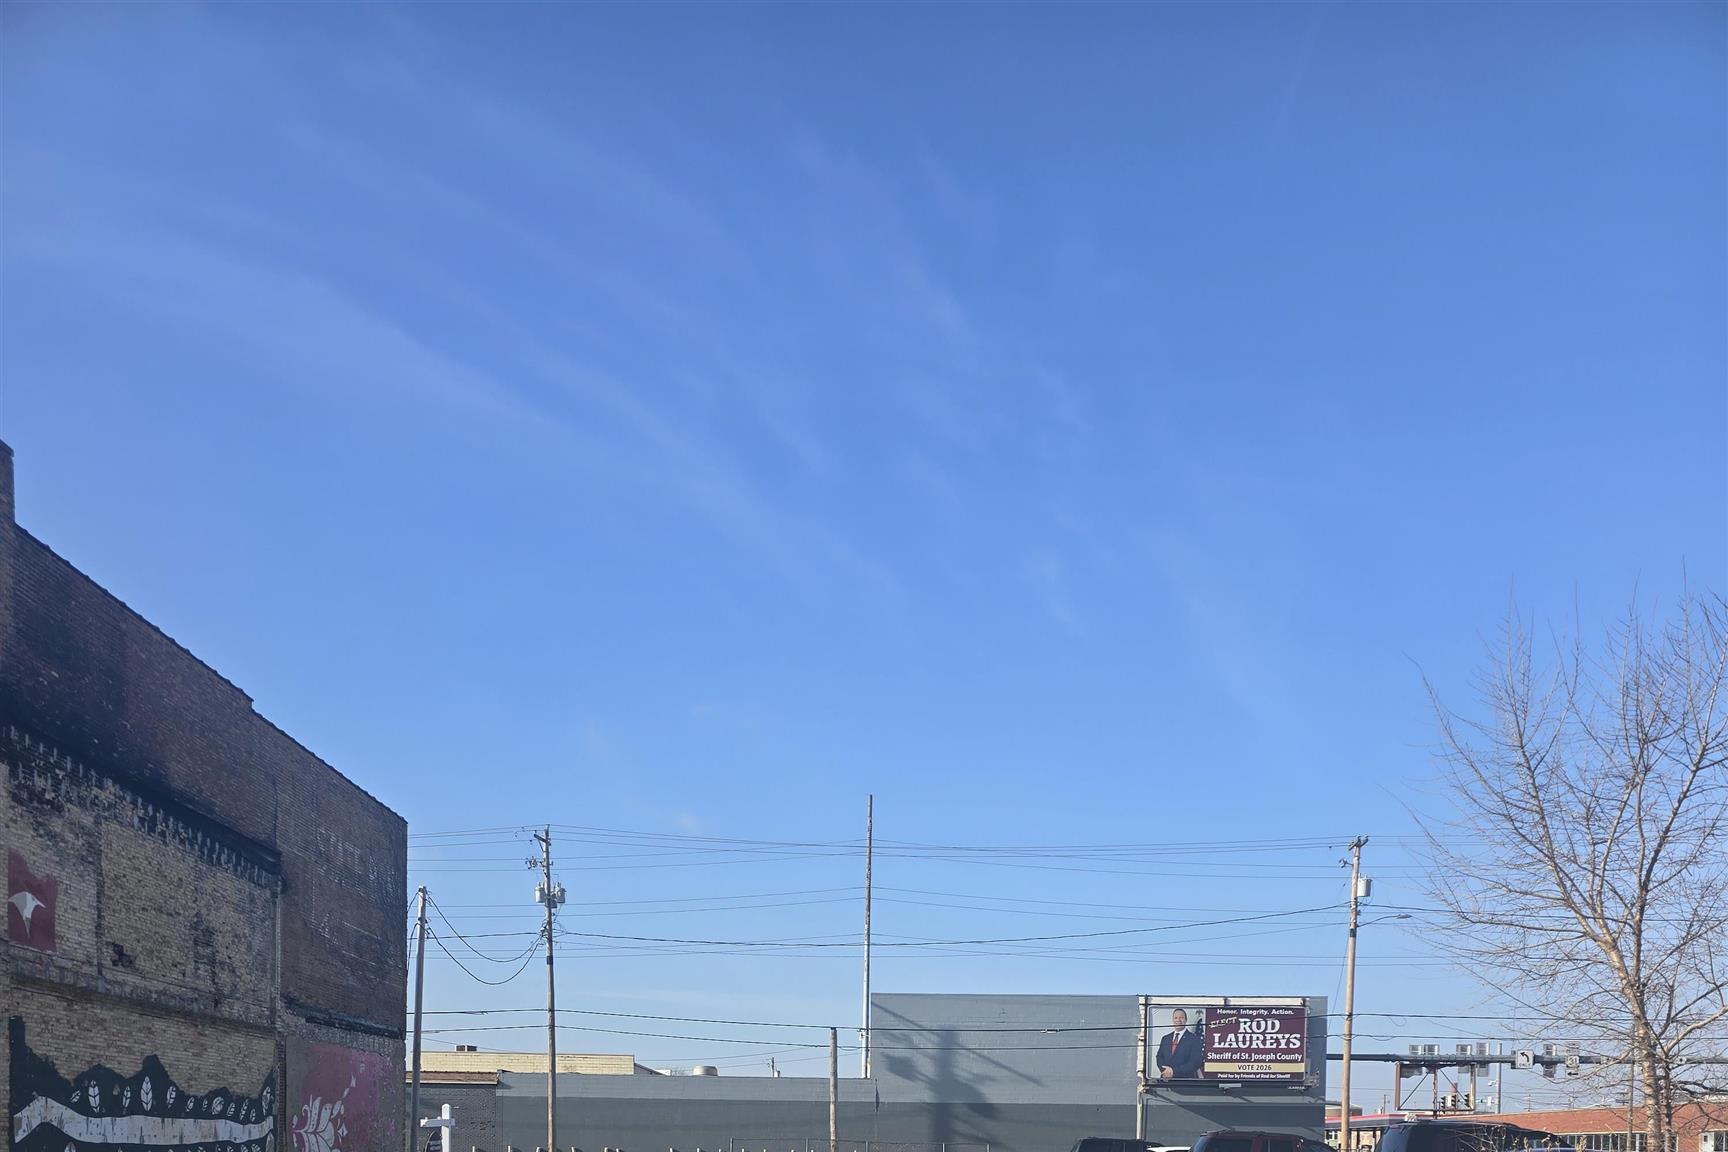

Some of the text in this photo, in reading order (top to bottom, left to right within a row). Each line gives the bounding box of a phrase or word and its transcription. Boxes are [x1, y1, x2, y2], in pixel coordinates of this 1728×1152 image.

[1240, 1008, 1269, 1016] Integrity.
[1238, 1018, 1280, 1033] ROD
[1212, 1033, 1301, 1048] LAUREYS
[1207, 1052, 1302, 1061] Sheriff of St. Joseph County
